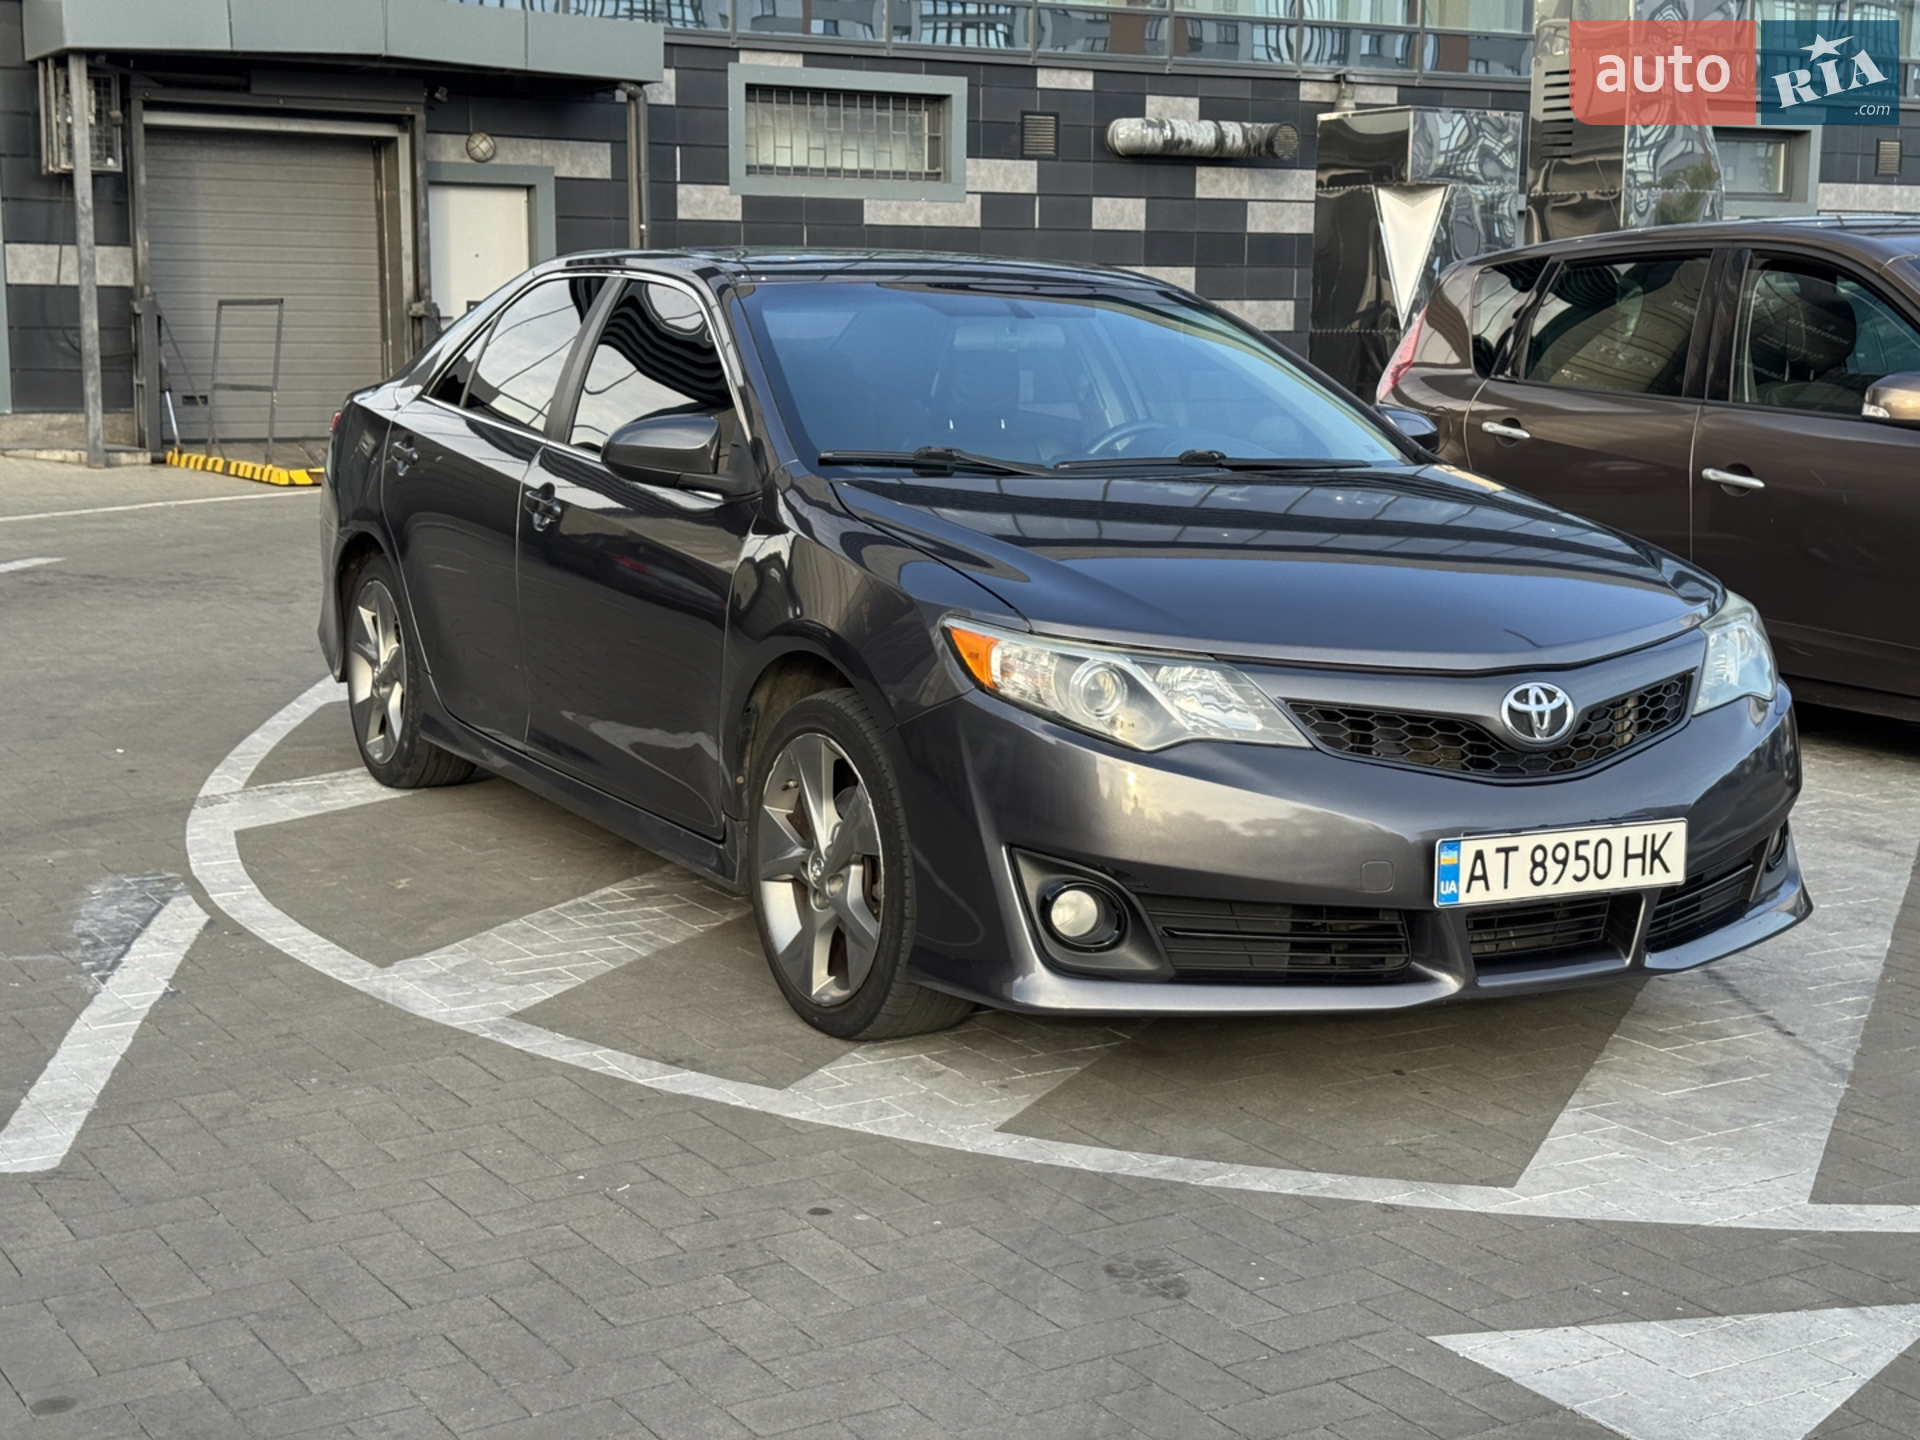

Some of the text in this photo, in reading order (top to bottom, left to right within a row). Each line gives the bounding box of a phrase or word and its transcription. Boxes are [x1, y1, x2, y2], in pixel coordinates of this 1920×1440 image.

[1465, 831, 1673, 894] AT 8950 HK
[1440, 881, 1457, 895] UA
